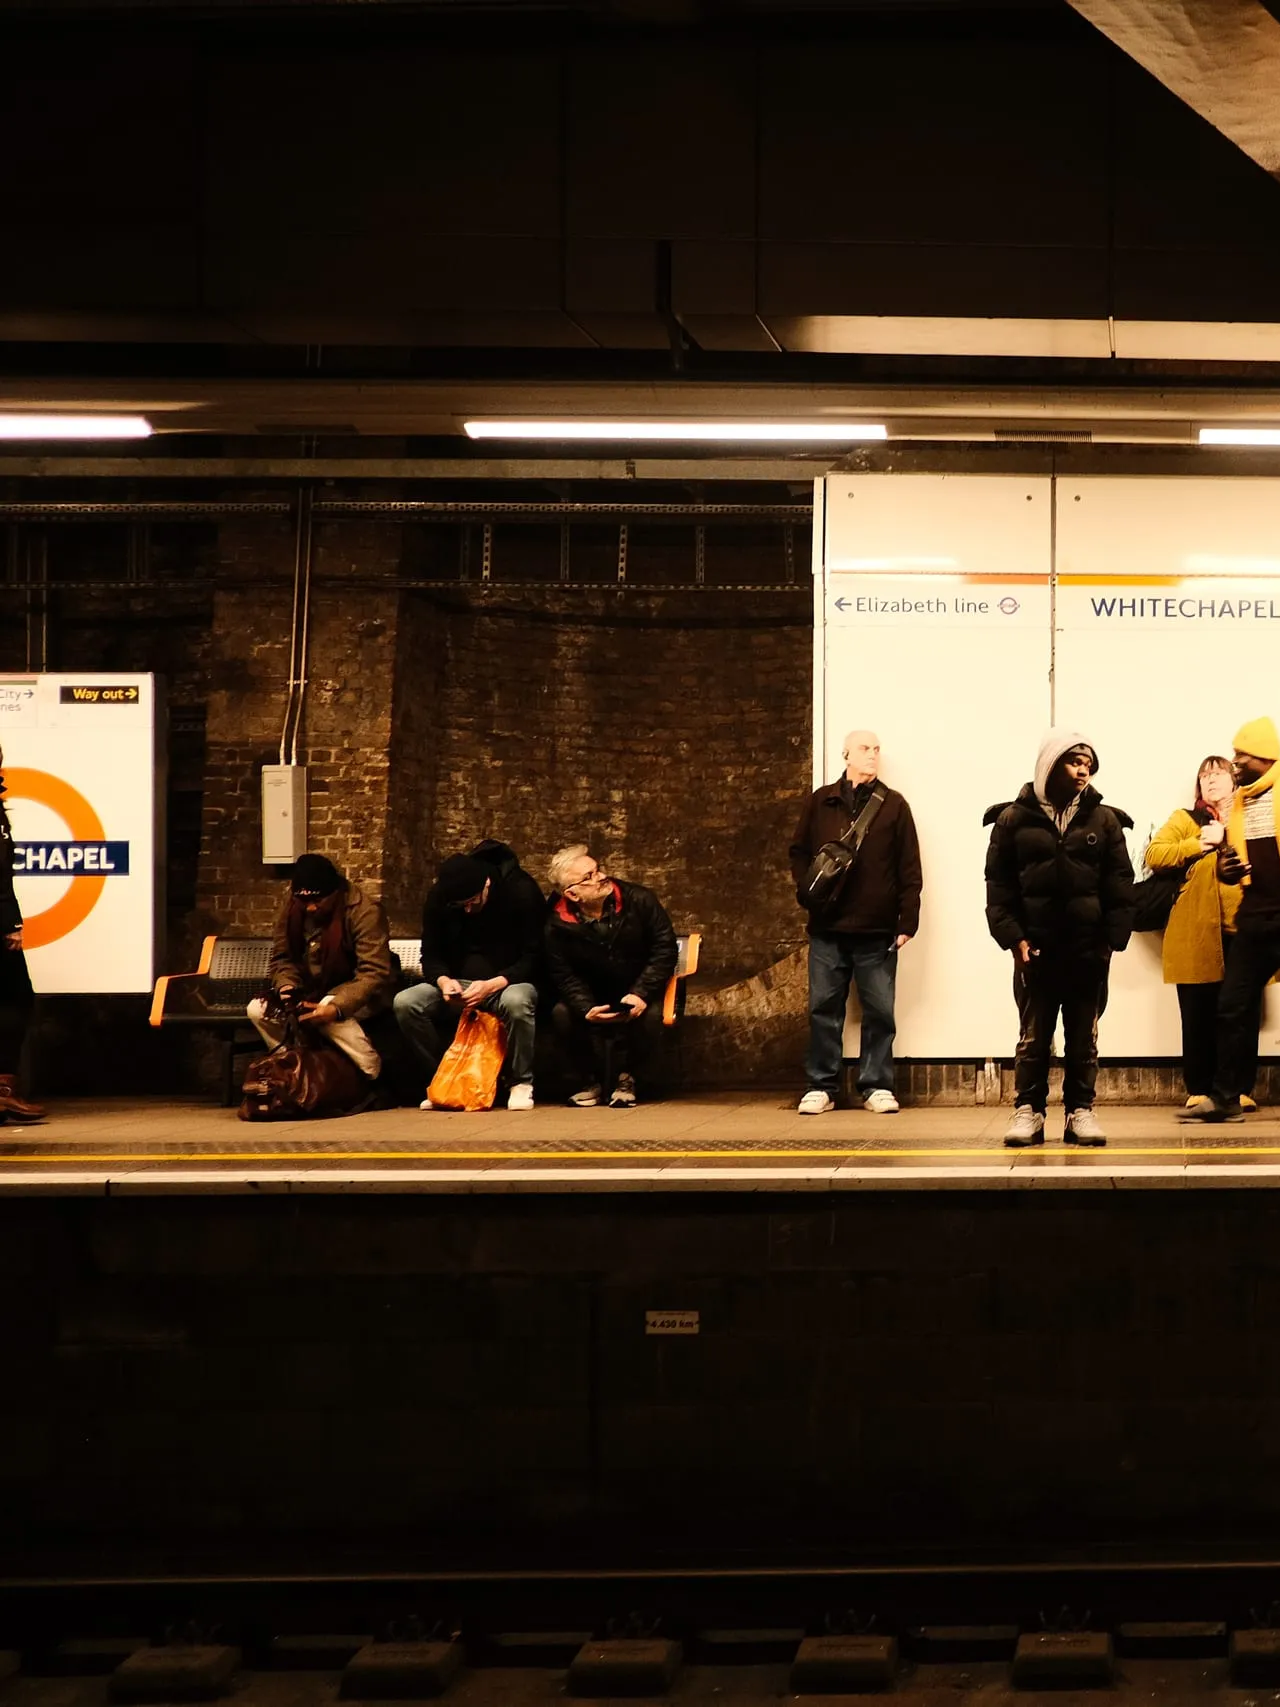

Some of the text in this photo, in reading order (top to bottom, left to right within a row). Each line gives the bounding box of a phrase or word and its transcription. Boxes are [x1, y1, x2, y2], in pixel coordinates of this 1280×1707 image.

[856, 597, 989, 613] Elizabeth line
[73, 688, 124, 701] Way out
